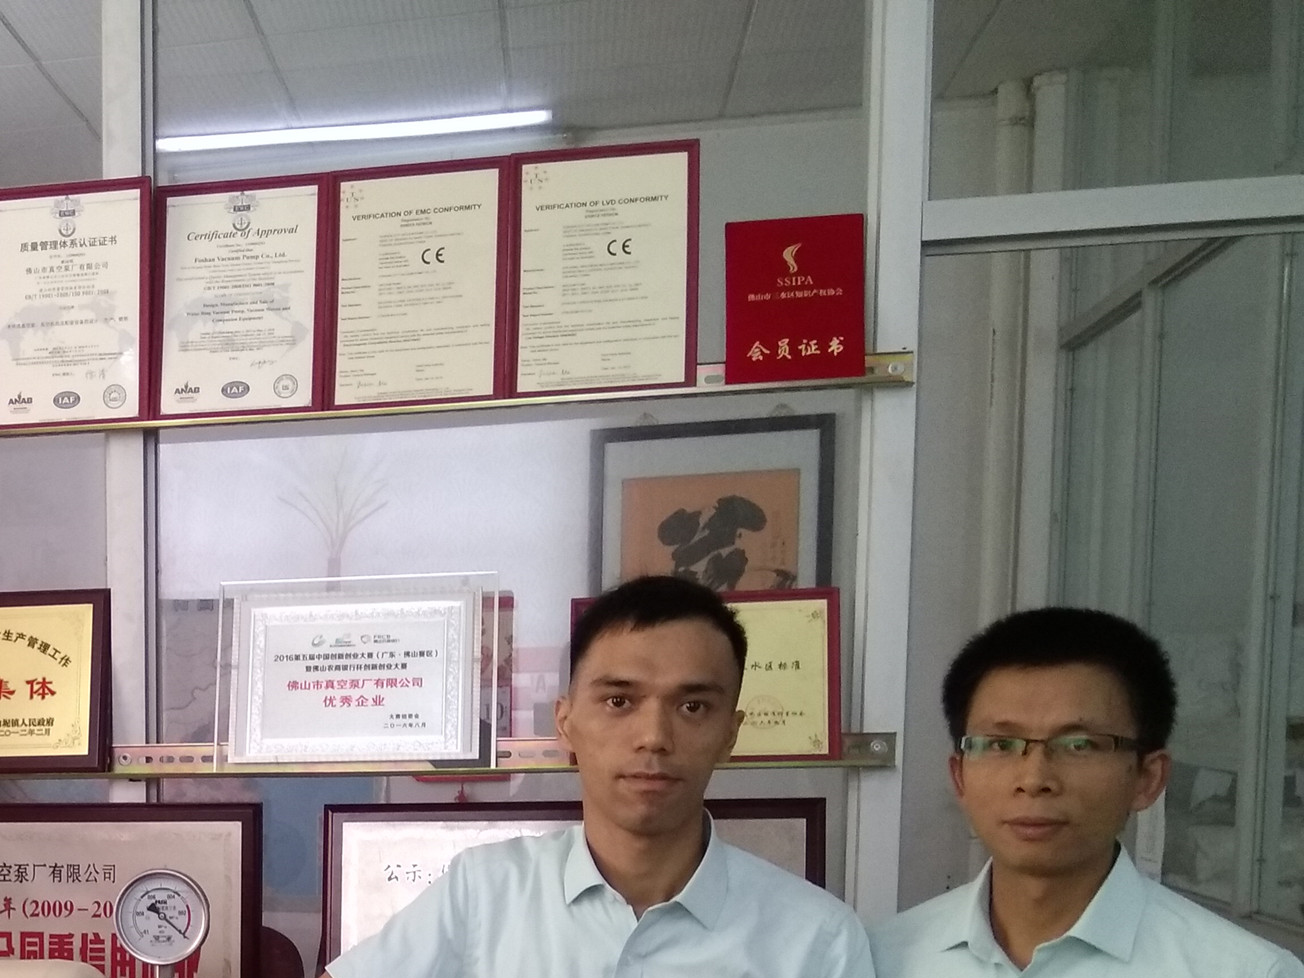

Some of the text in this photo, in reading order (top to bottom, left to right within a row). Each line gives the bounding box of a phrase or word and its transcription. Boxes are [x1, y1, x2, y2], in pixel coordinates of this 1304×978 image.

[352, 211, 402, 221] VERIFICATION
[415, 208, 431, 216] EMC
[433, 203, 483, 214] CONFORMITY
[535, 201, 587, 212] VERIFICATION
[618, 195, 669, 205] CONFORMITY
[186, 225, 299, 242] Certificate of Approval
[20, 235, 117, 252] 质量管理体系认证证书
[607, 238, 632, 256] CE
[242, 254, 260, 262] Pump
[421, 247, 445, 265] CE
[777, 275, 814, 287] SSIPA
[746, 336, 845, 362] 会员证书
[287, 677, 423, 692] 佛山市真空泵厂有限公司
[323, 694, 385, 708] 优秀企业
[384, 863, 446, 885] 公示:
